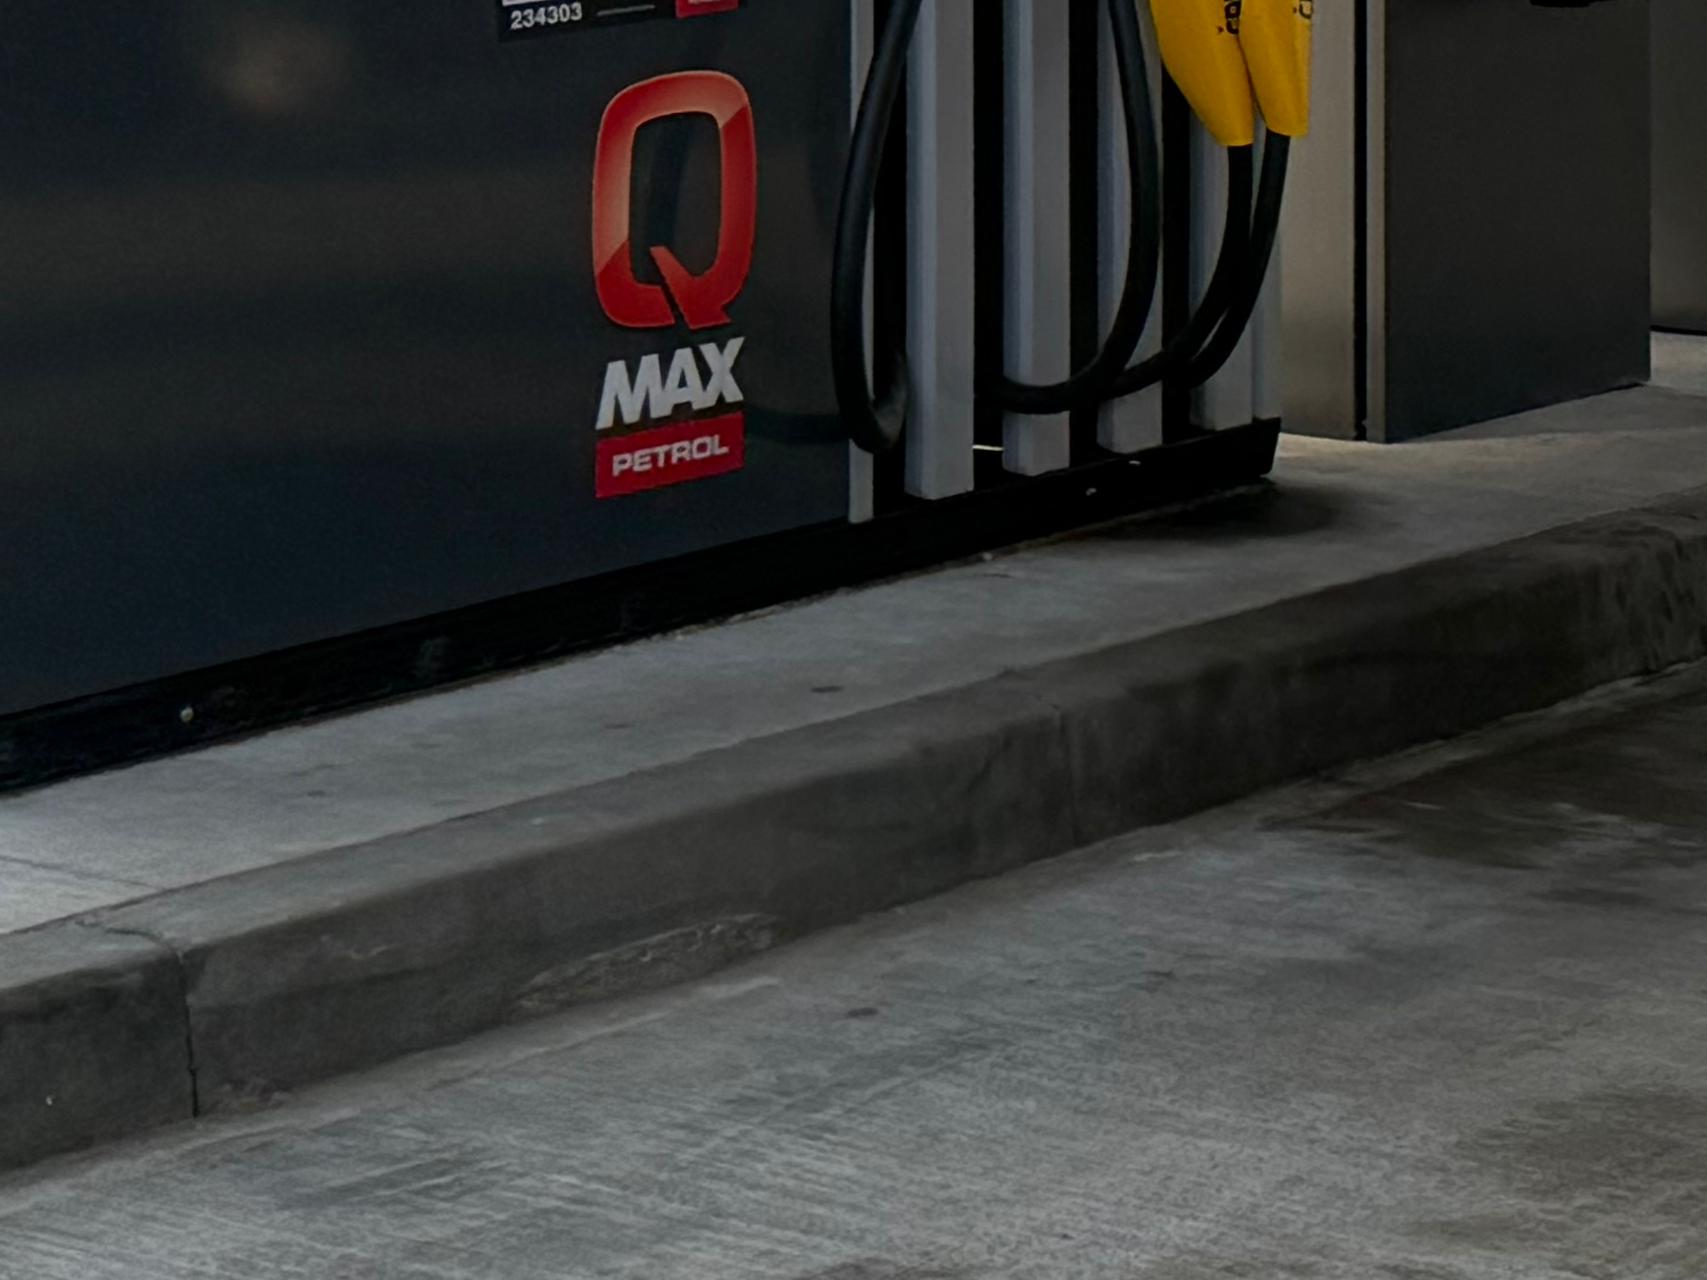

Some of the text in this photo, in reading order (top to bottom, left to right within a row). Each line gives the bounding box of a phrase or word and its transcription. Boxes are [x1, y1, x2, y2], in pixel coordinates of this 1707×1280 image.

[510, 1, 583, 31] 234303
[592, 70, 758, 330] Q
[595, 337, 746, 431] MAX
[611, 434, 731, 478] PETROL
